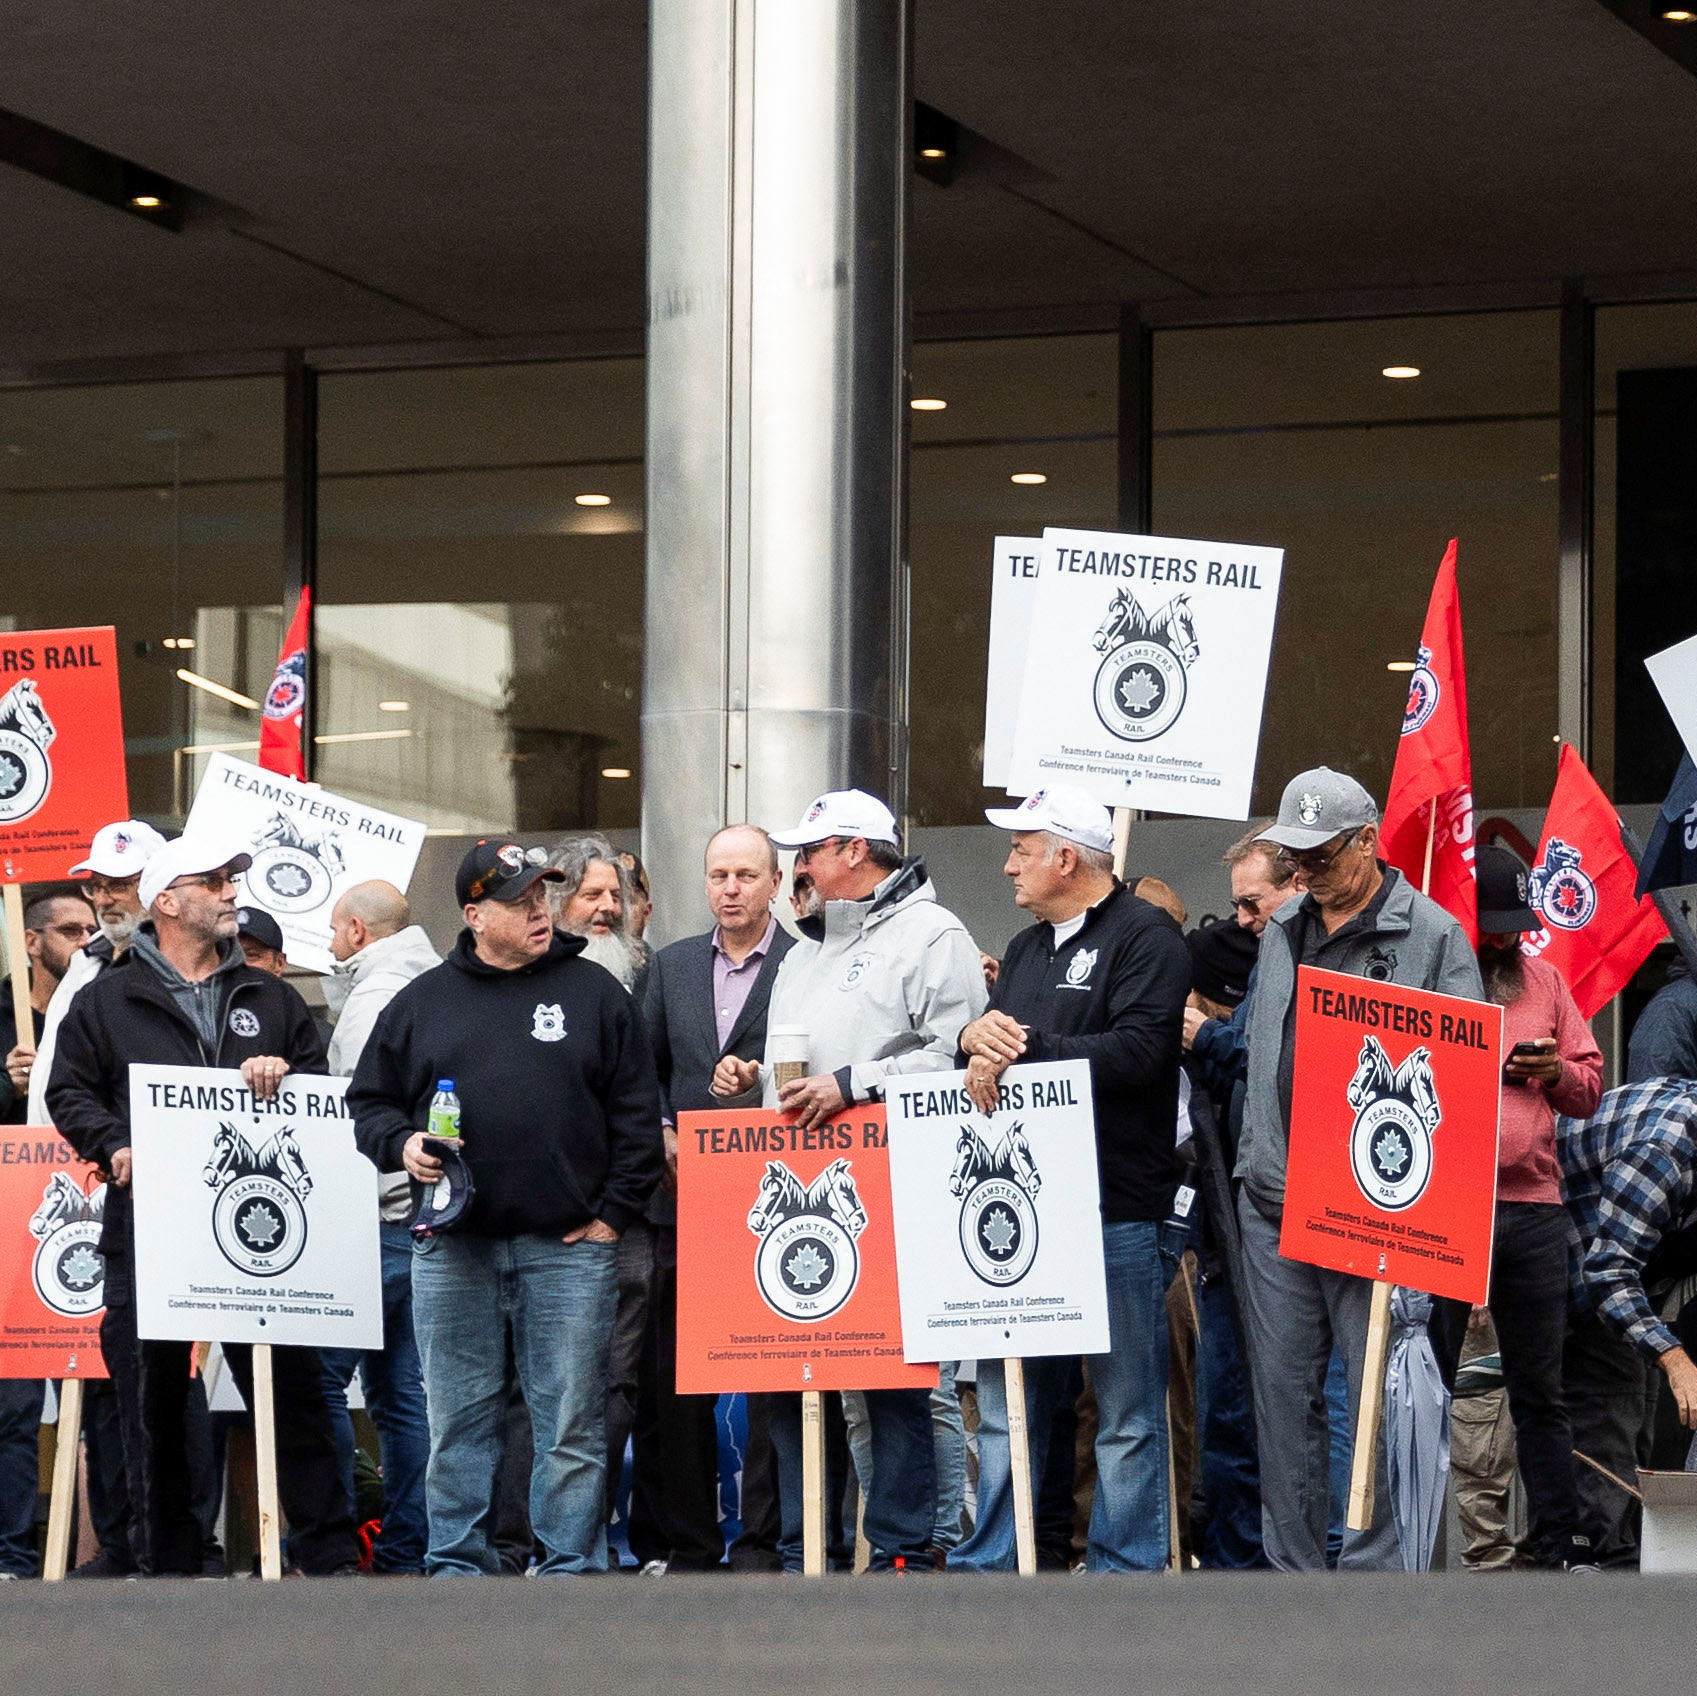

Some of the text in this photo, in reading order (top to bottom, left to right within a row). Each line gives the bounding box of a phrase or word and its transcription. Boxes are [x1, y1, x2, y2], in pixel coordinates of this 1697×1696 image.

[1056, 548, 1262, 590] TEAMSTERS RAIL
[45, 645, 101, 669] RAIL
[1114, 648, 1173, 672] TEAMSTERS
[1124, 723, 1145, 732] RAIL
[1060, 745, 1202, 768] Teamsters Canada Rail Conference
[1039, 759, 1220, 786] Conférence ferroviaire de Teamsters Canada
[223, 768, 406, 845] TEAMSTERS RAIL
[1310, 987, 1488, 1050] TEAMSTERS RAIL
[900, 1079, 1078, 1118] TEAMSRS RAIL
[1368, 1106, 1418, 1135] TEAMSTERS
[695, 1124, 852, 1153] TEAMSTERS
[230, 1182, 289, 1206] TEAMSTERS
[972, 1187, 1022, 1209] TEAMSTERS
[1379, 1188, 1397, 1198] RAIL
[775, 1223, 840, 1245] TEAMSTERS
[1324, 1207, 1447, 1244] Teamsters Canada Rail Conference
[250, 1259, 273, 1267] RAIL
[994, 1268, 1012, 1276] RAIL
[189, 1284, 334, 1300] Teamsters Canada Rail Conference
[944, 1296, 1064, 1311] Teamsters Canada Rail Conference
[168, 1299, 354, 1317] Conférence ferroviaire de Teamsters Canada
[927, 1312, 1082, 1328] Conférence ferroviaire de Teamsters Canada
[729, 1331, 885, 1344] Teamsters Canada Rail Conference
